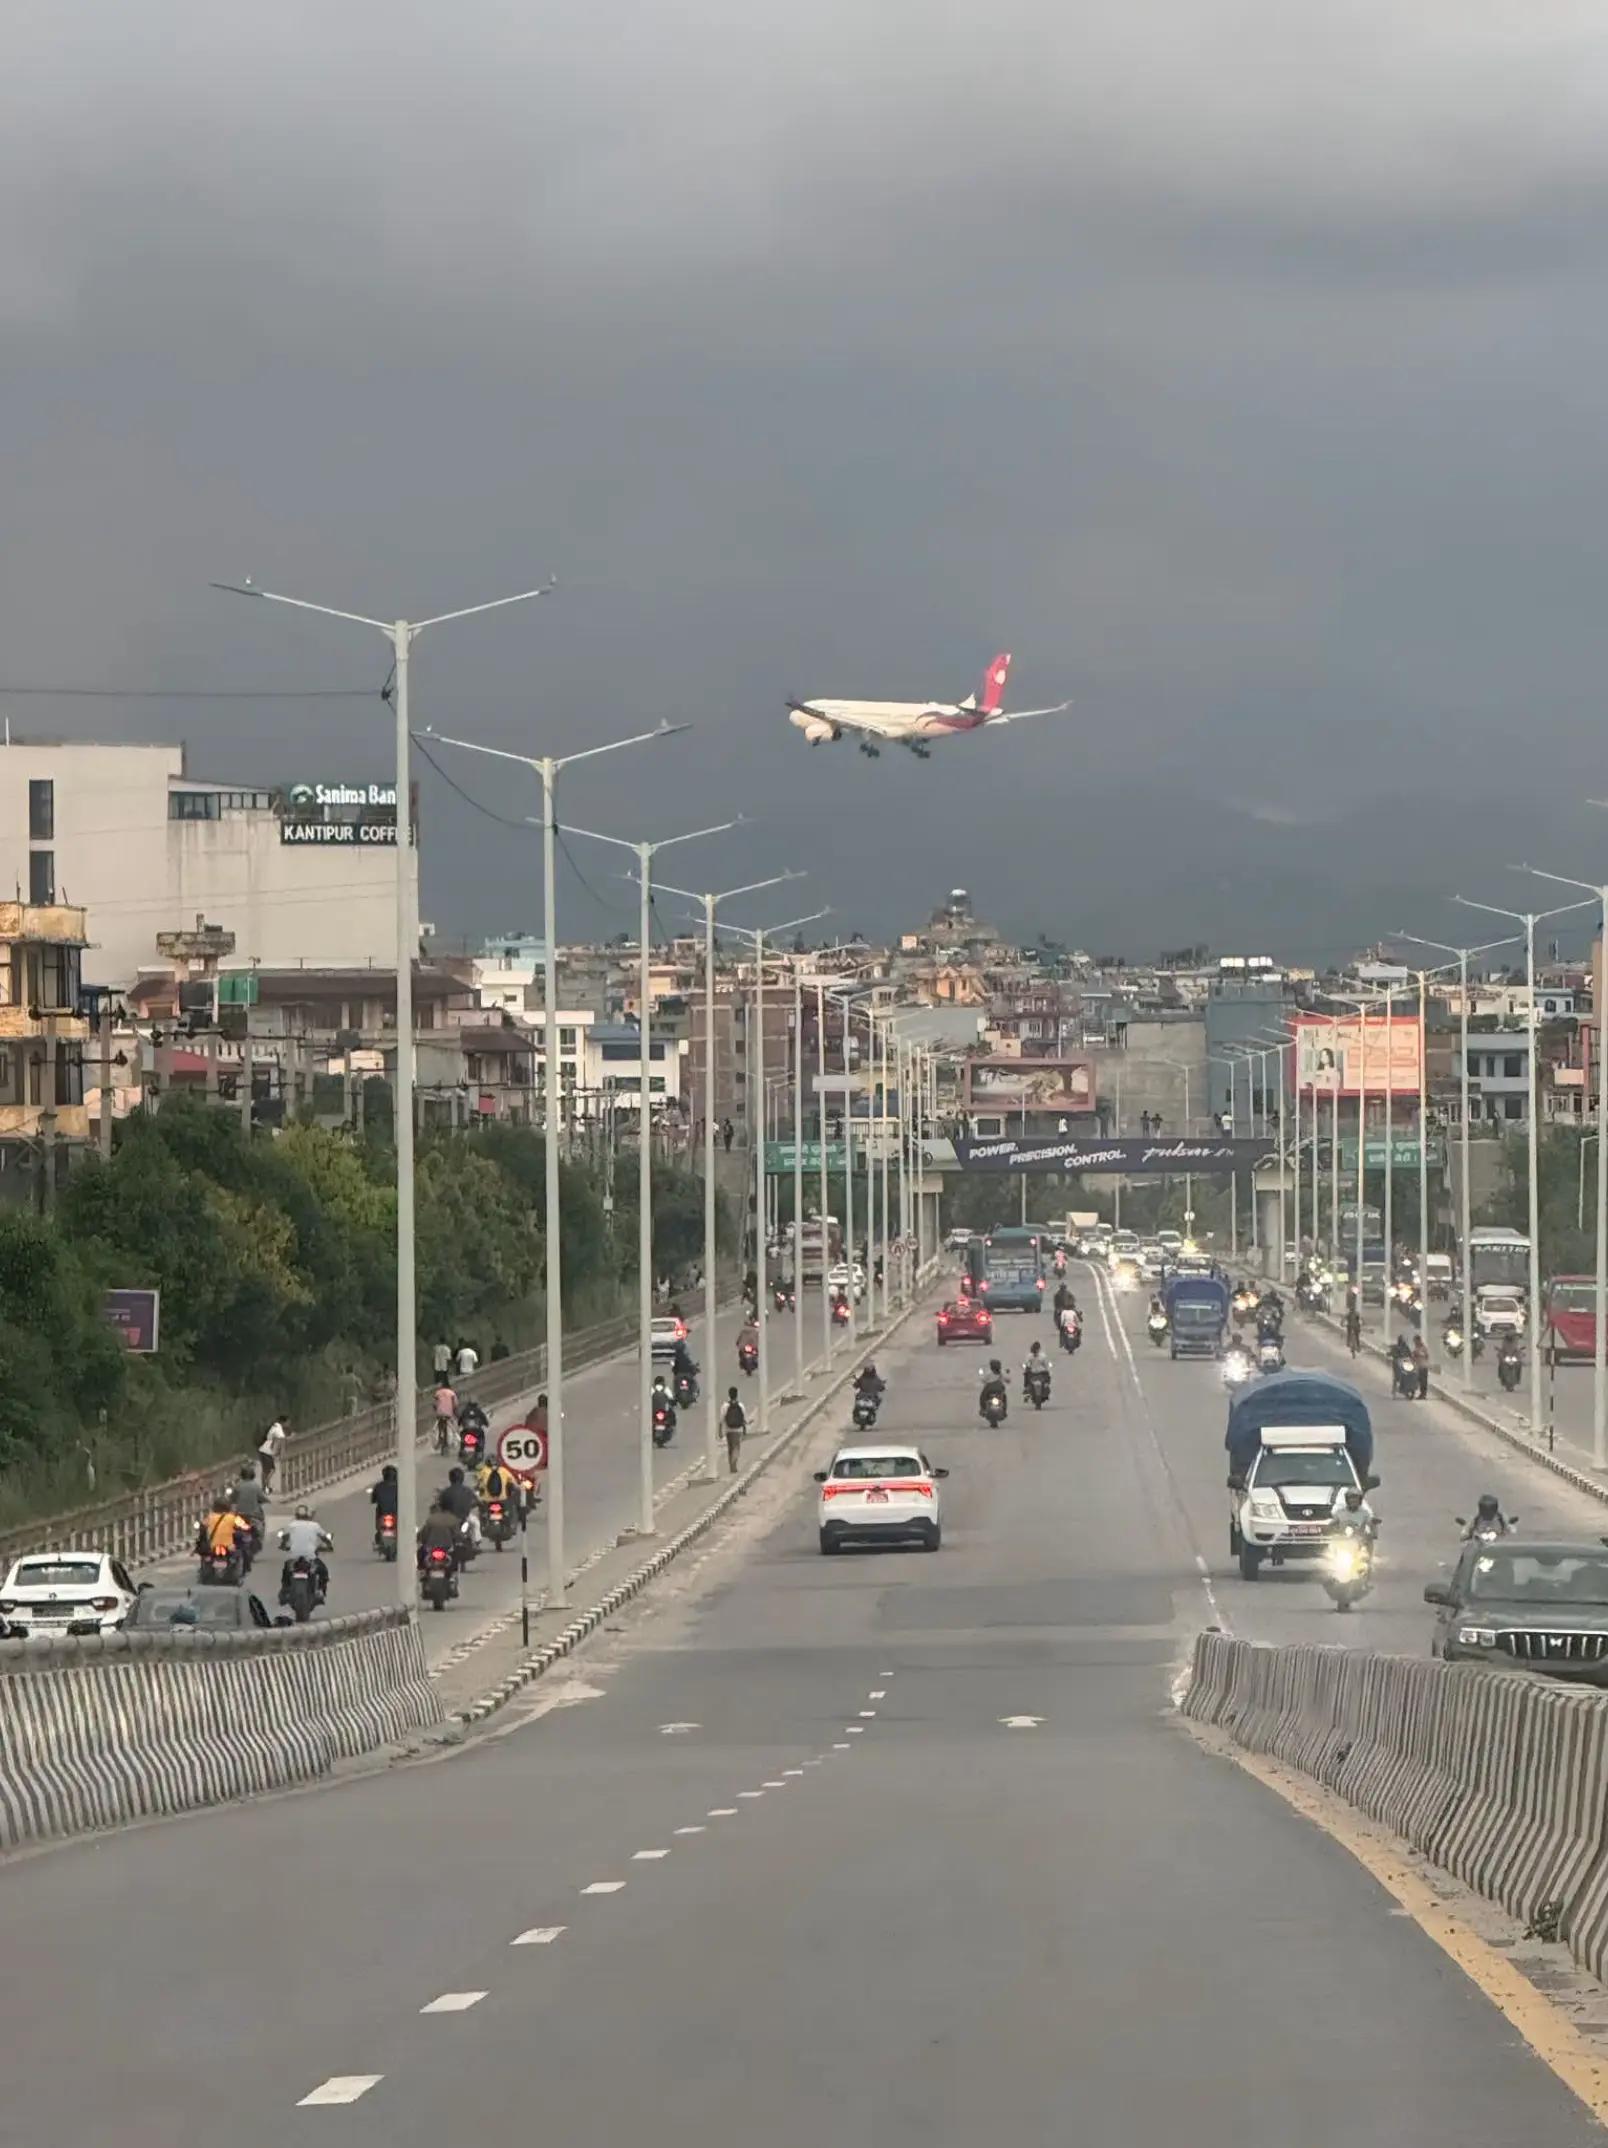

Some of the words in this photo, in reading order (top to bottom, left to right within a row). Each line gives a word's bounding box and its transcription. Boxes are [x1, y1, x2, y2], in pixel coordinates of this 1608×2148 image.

[315, 784, 366, 804] Sanima
[368, 784, 397, 805] Ban
[284, 825, 354, 841] KANTIPUR
[969, 1142, 1019, 1160] POWER.
[1009, 1143, 1078, 1166] PRECISION.
[1063, 1149, 1127, 1169] CONTROL.
[506, 1439, 540, 1460] 50
